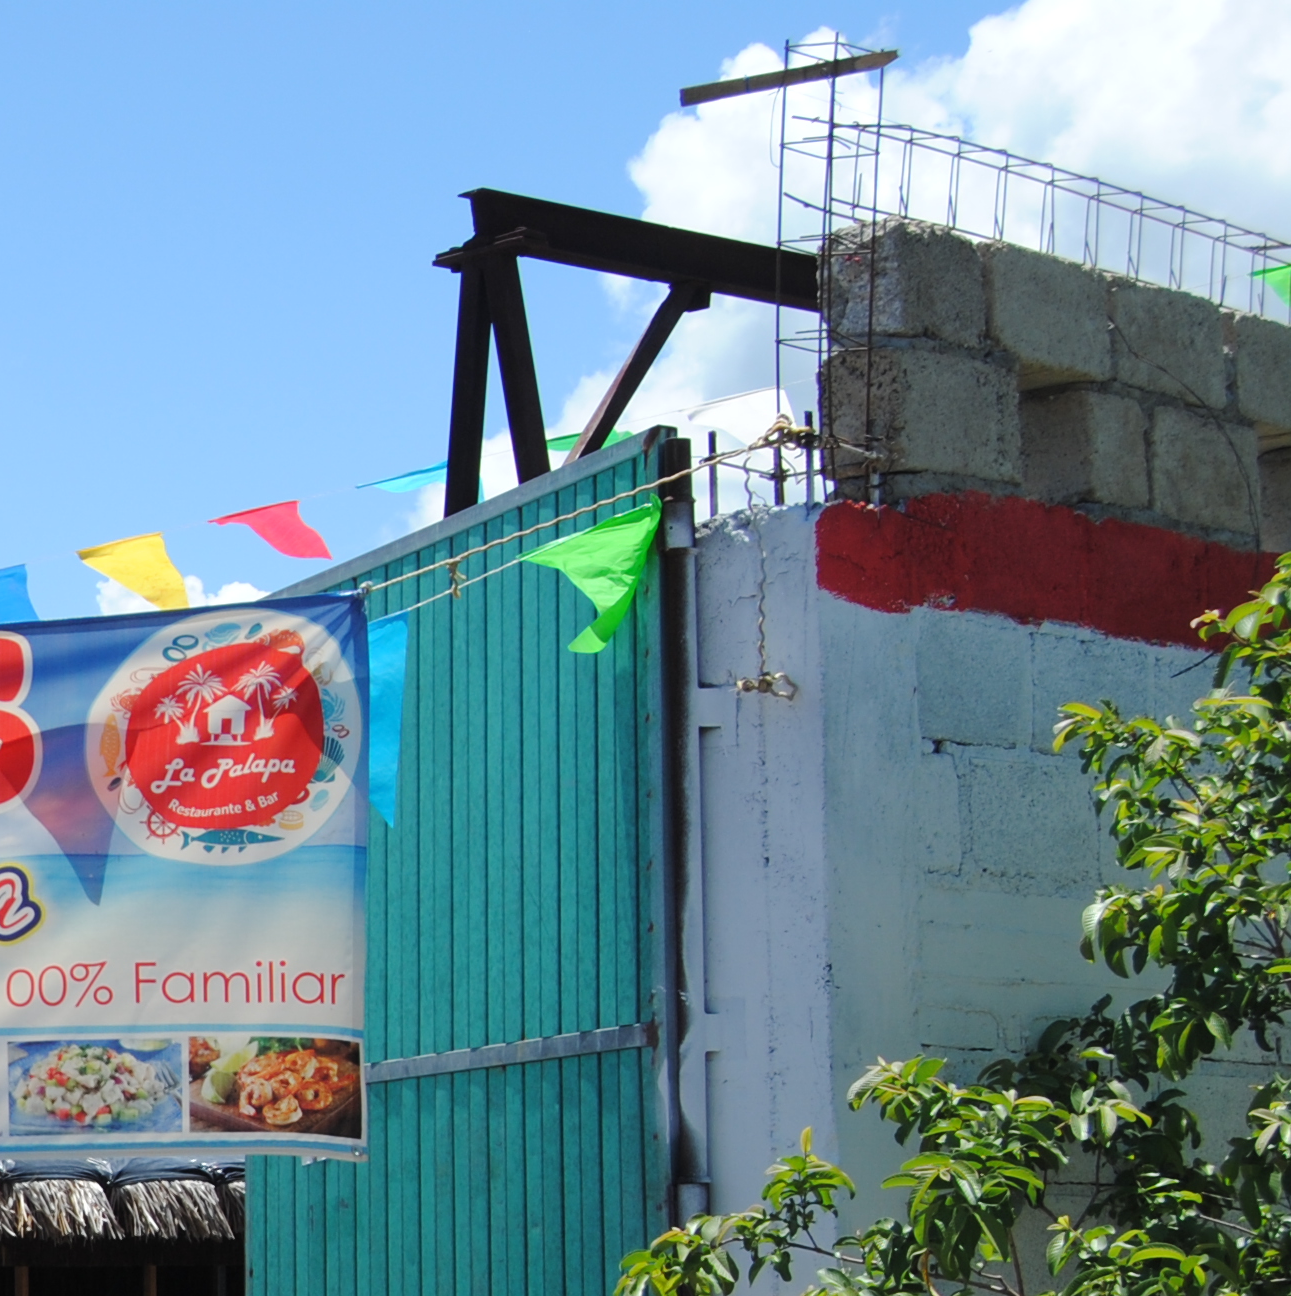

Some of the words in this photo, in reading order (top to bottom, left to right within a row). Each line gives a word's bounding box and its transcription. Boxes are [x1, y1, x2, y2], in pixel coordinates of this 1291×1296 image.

[150, 758, 195, 794] La
[201, 753, 296, 788] Palapa
[168, 797, 242, 817] Restaurante
[257, 791, 279, 809] Bar
[133, 958, 345, 1006] Familiar
